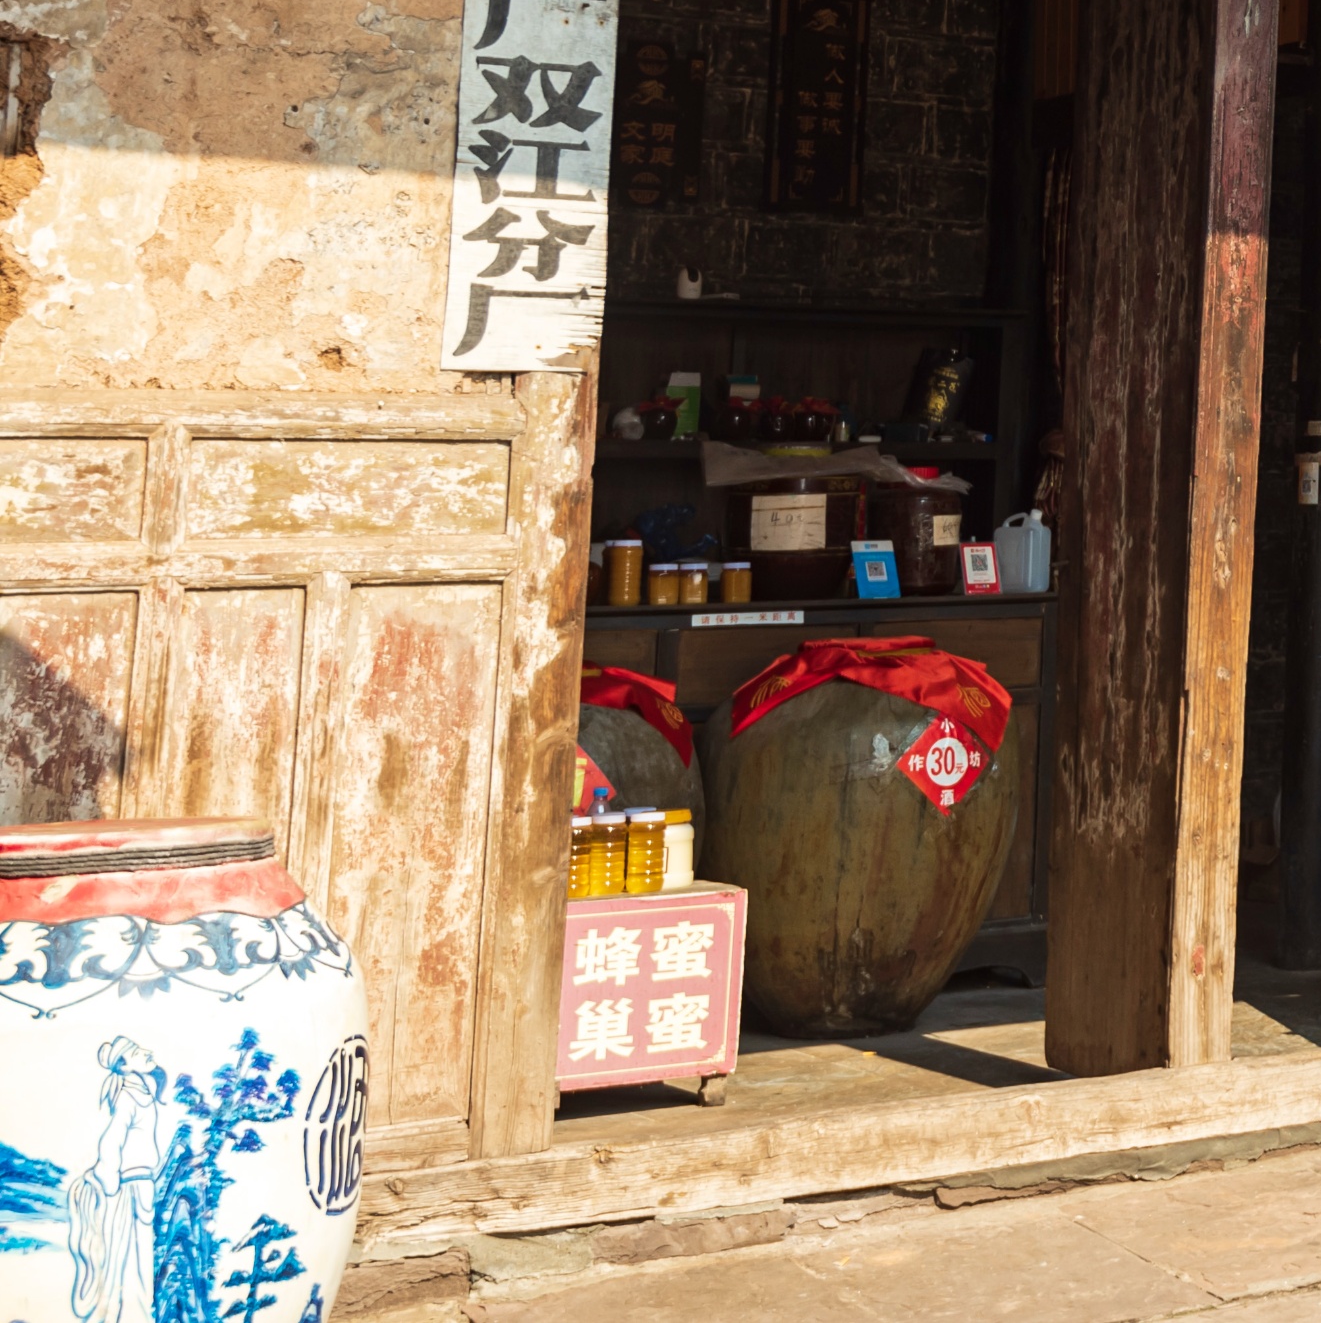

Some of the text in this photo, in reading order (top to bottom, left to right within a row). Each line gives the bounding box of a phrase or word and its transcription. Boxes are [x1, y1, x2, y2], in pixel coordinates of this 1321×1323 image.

[620, 120, 676, 143] 文明
[701, 610, 796, 624] 请保持一米距离
[908, 754, 925, 771] 作
[969, 751, 981, 767] 坊
[939, 789, 955, 806] 酒
[572, 921, 715, 987] 蜂蜜
[568, 992, 710, 1062] 巢蜜
